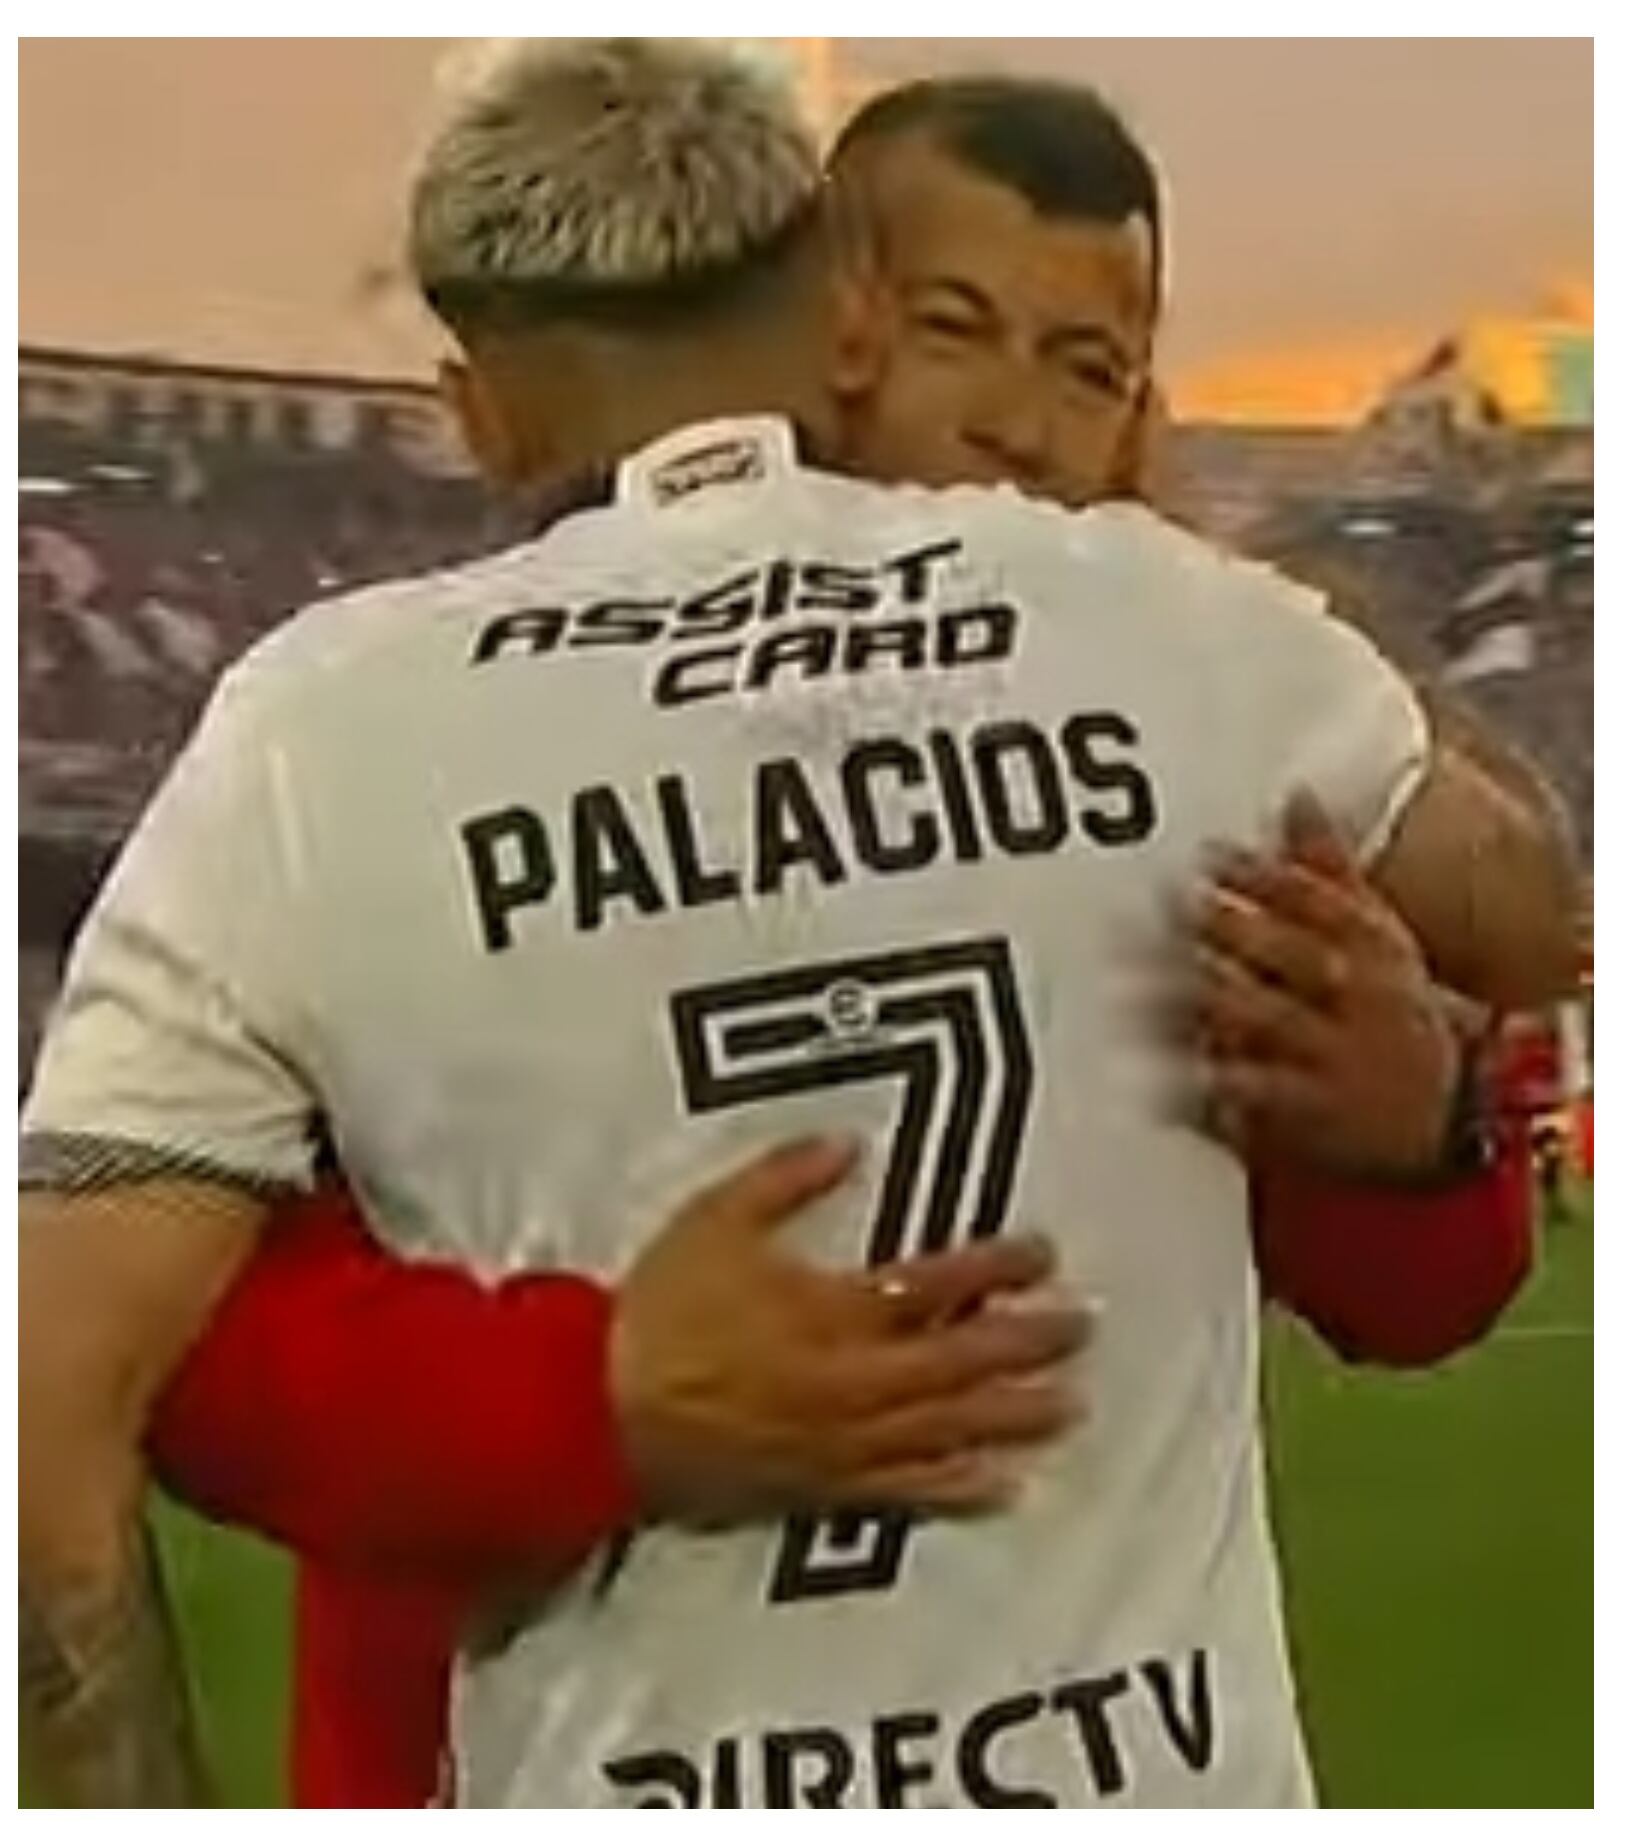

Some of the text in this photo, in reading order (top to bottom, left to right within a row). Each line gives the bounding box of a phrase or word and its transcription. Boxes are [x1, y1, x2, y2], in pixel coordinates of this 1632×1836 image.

[470, 540, 963, 665] ASSIST
[653, 604, 1018, 707] CARD
[460, 711, 1158, 954] PALACIOS
[671, 934, 1033, 1603] 7
